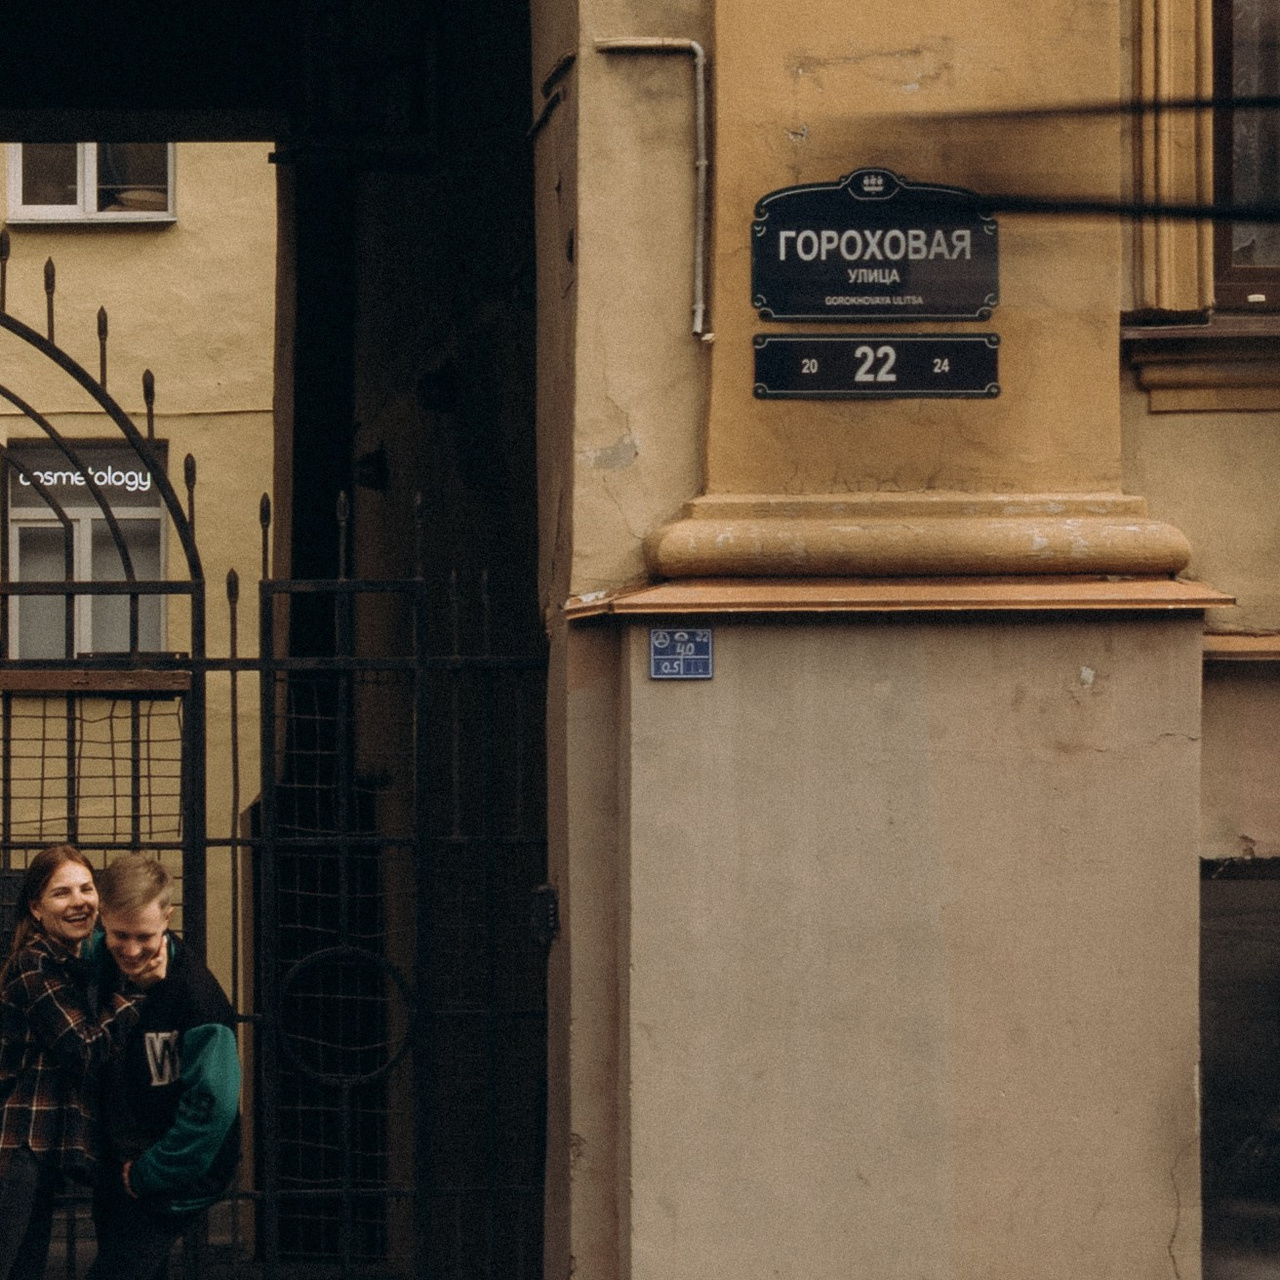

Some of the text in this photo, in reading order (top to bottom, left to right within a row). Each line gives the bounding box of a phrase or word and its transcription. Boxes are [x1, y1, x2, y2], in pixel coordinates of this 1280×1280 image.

[778, 229, 971, 261] ГОРОХОВАЯ
[847, 268, 900, 285] УЛИЦА
[892, 296, 923, 305] ULITSA
[801, 345, 949, 382] 20 22 24
[144, 1030, 181, 1087] W
